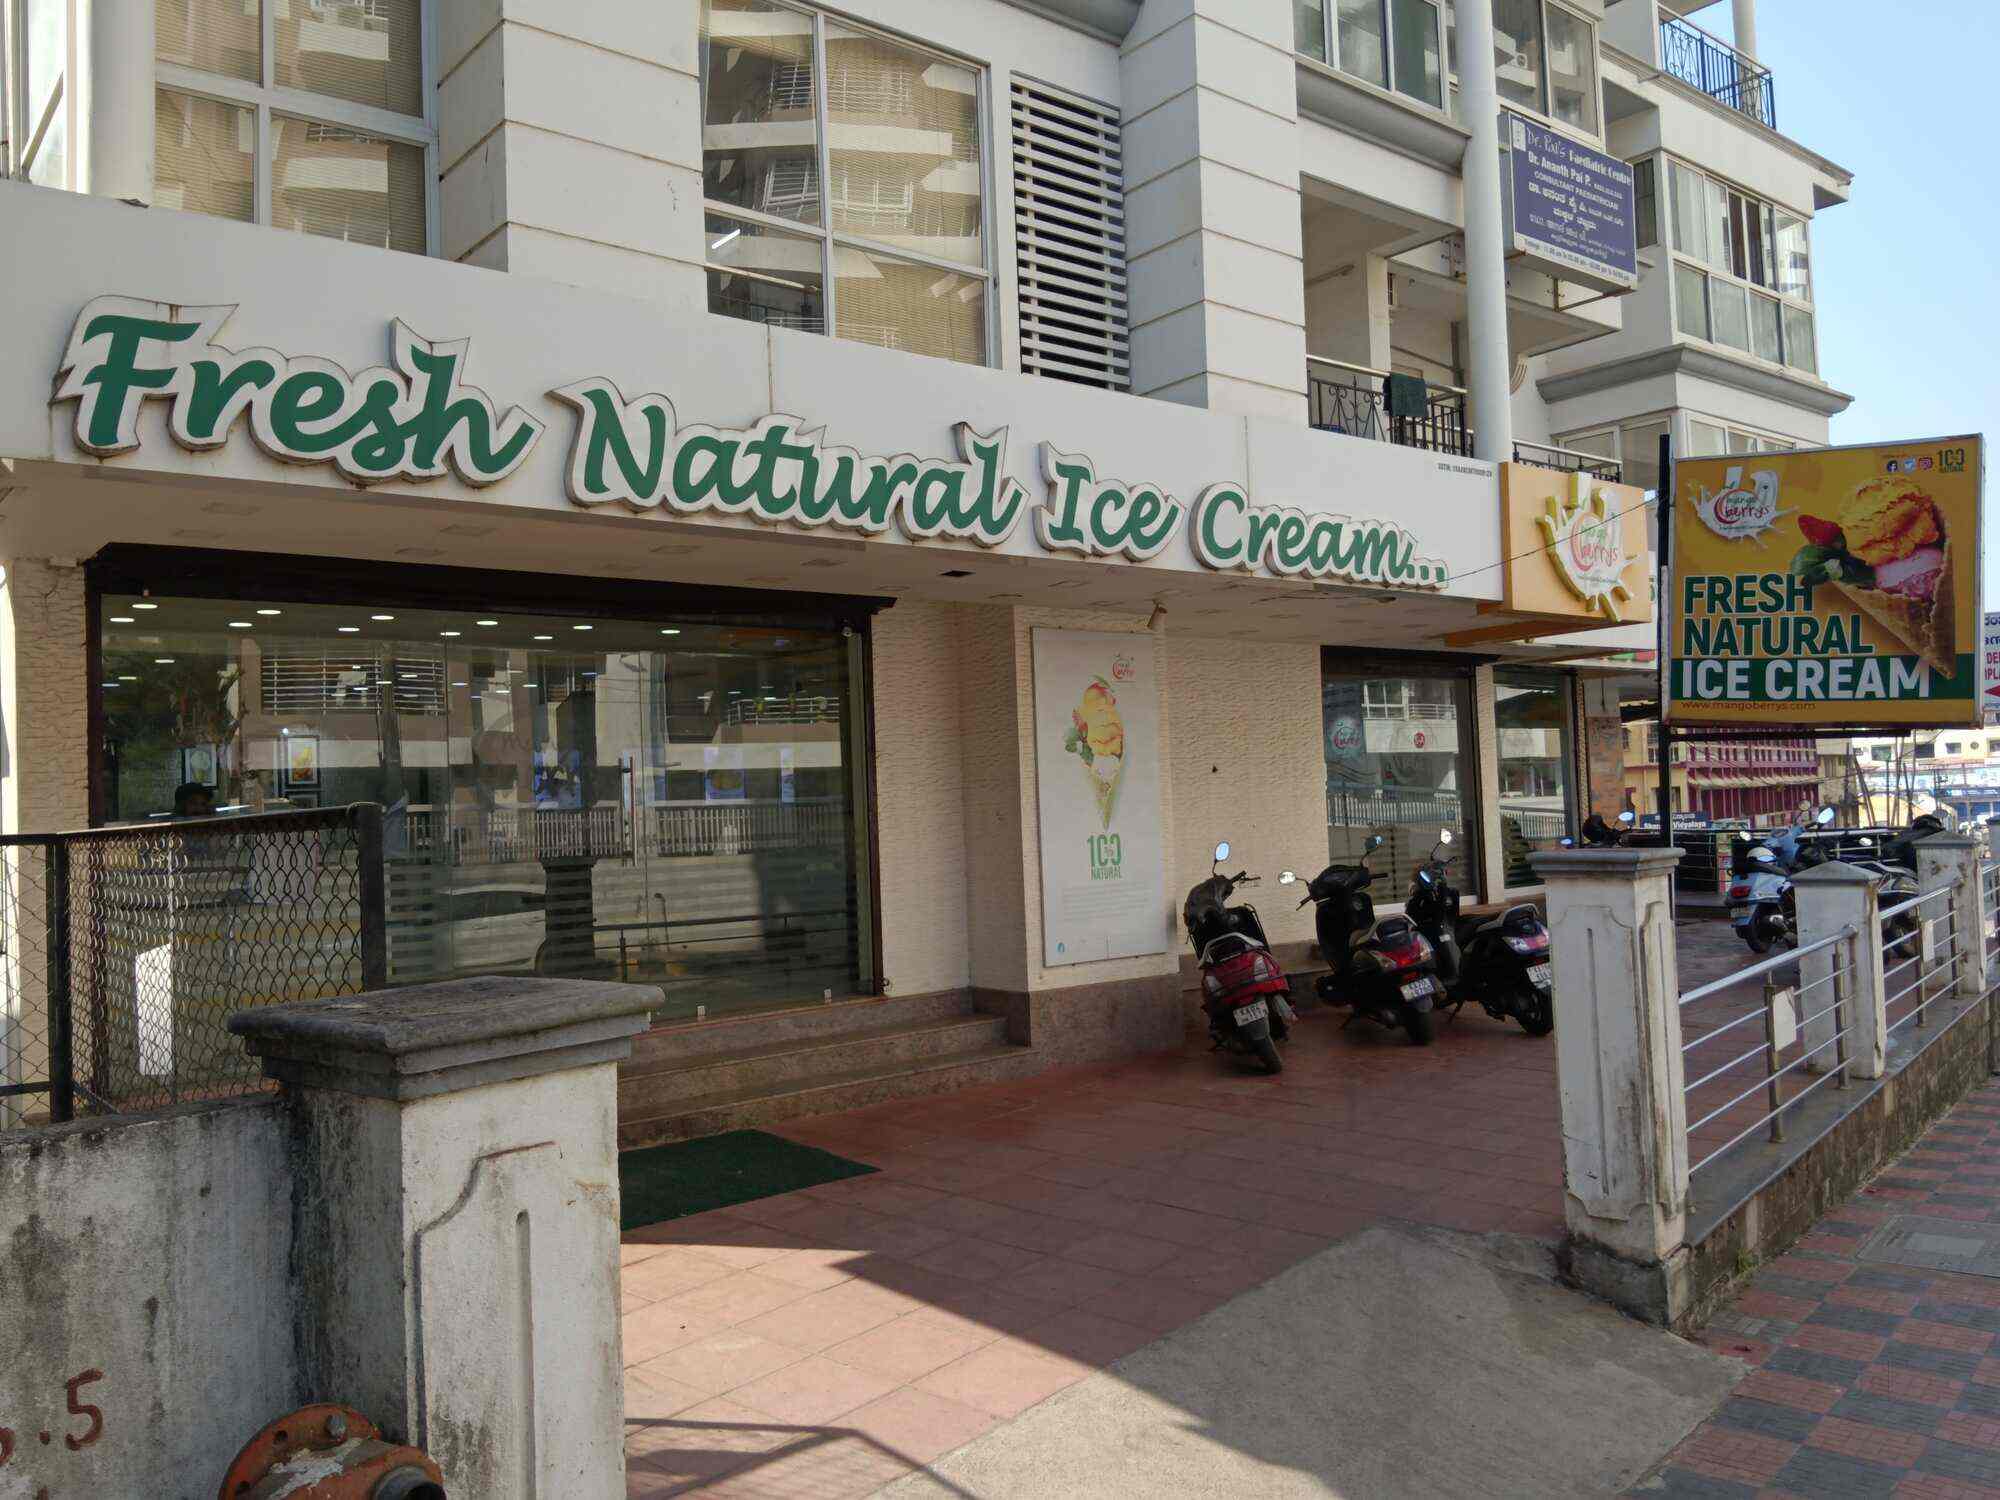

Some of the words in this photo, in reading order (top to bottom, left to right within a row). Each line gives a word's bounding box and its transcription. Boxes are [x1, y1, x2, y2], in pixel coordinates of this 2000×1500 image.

[1541, 156, 1569, 179] Ananth
[1571, 167, 1583, 183] Pai
[81, 314, 535, 474] Fresh
[581, 387, 1023, 537] Natural
[1048, 462, 1180, 552] Ice
[1683, 574, 1813, 614] FRESH
[1682, 614, 1876, 656] NATURAL
[1682, 659, 1750, 699] ICE
[1765, 656, 1930, 699] CREAM
